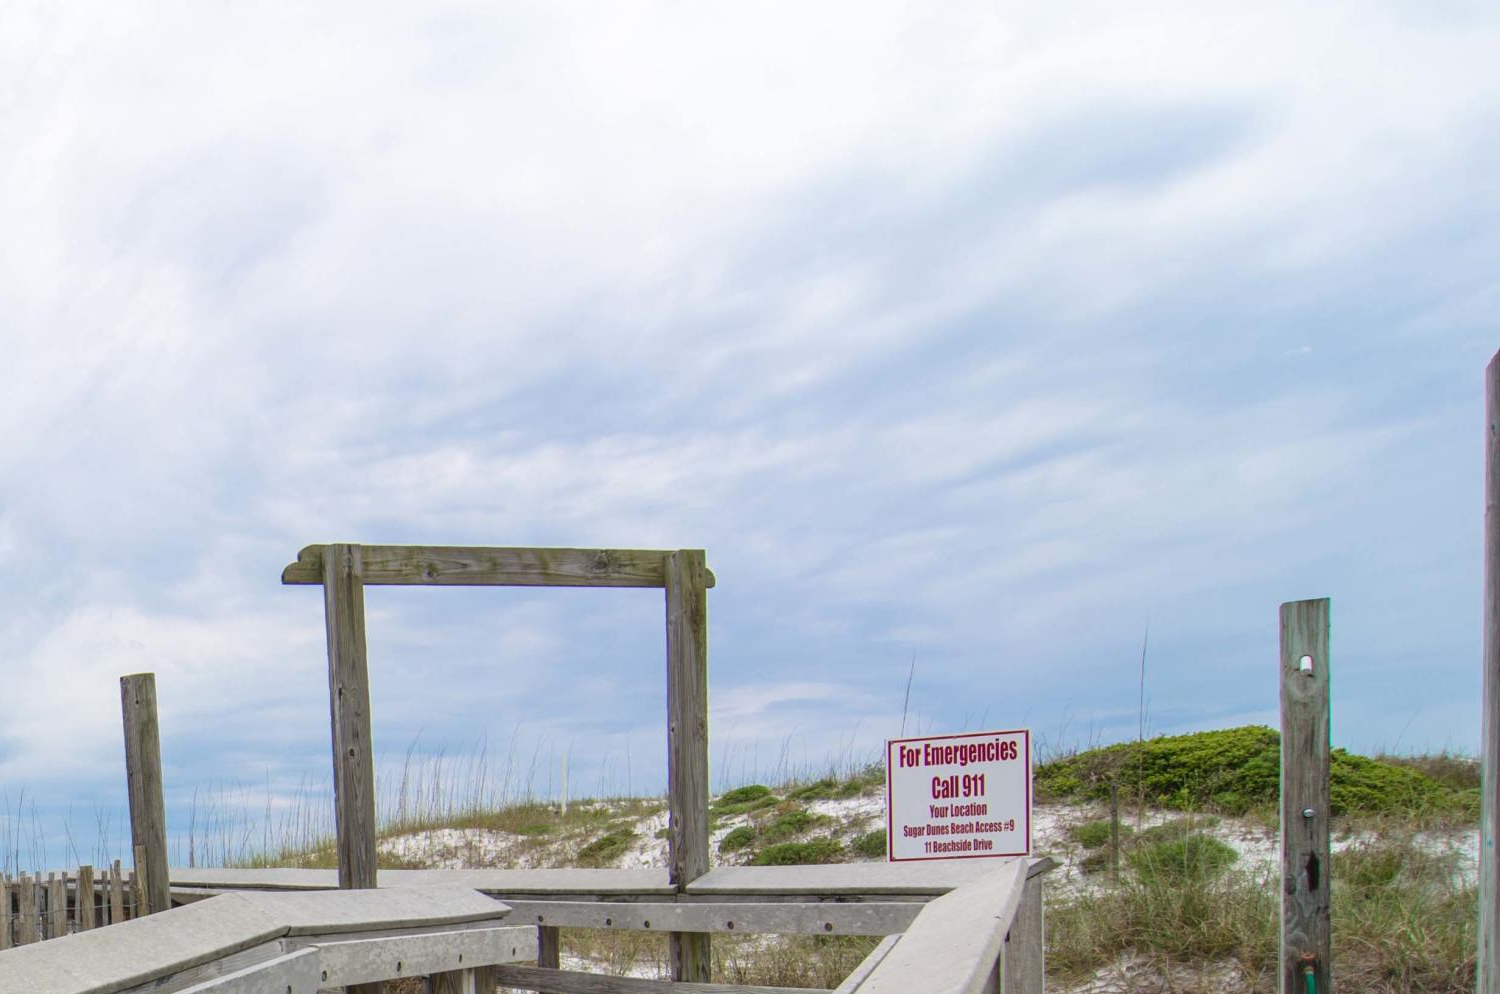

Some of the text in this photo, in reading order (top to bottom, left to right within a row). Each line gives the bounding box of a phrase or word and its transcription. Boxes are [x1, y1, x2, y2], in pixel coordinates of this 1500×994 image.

[900, 738, 1018, 768] For Emergencies
[932, 773, 985, 799] Call 911
[930, 802, 988, 818] Your Location
[903, 818, 1015, 838] Sugar Dunes Beach Access #9
[925, 838, 993, 853] 11 Beachside Drive
